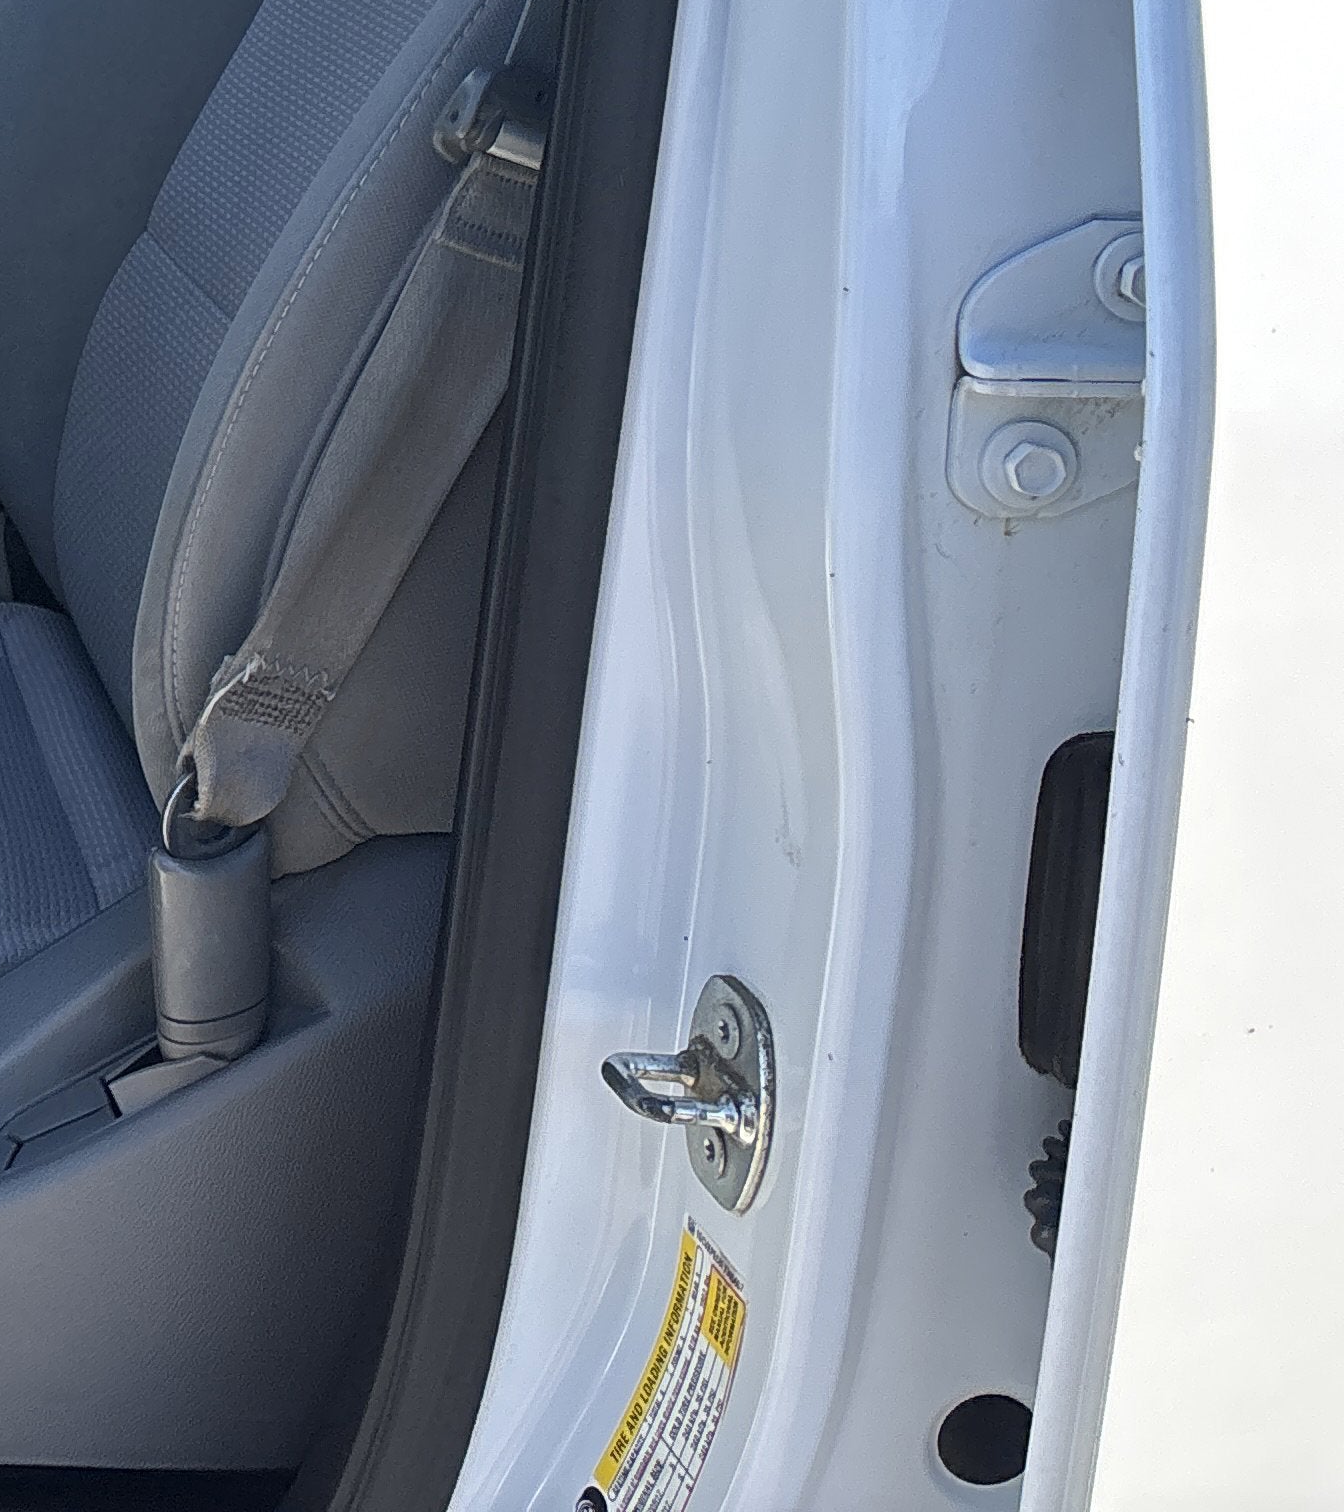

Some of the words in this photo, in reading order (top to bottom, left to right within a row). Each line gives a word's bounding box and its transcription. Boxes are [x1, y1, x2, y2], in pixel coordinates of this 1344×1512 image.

[610, 1434, 630, 1463] TIRE
[626, 1404, 643, 1430] AND
[642, 1347, 668, 1402] LOADING
[664, 1252, 693, 1346] INFORMATION
